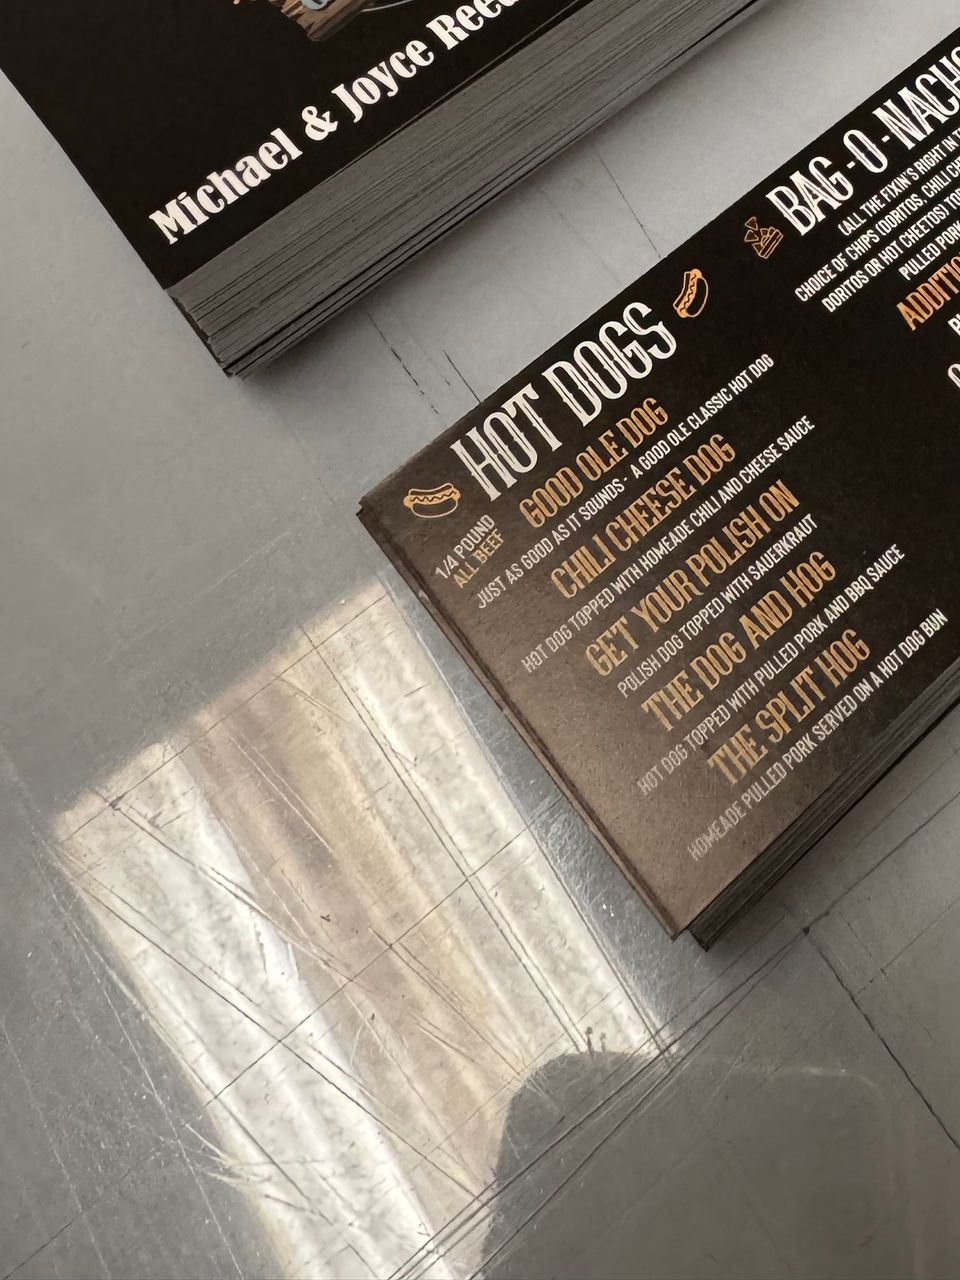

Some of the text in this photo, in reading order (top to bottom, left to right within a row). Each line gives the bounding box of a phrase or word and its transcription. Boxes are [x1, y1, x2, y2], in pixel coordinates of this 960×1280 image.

[149, 128, 302, 244] Michael
[302, 106, 338, 140] &
[331, 41, 434, 122] Joyce
[837, 212, 867, 236] (ALL
[859, 194, 886, 218] THE
[879, 167, 920, 203] FIXIN'S
[913, 143, 947, 175] RIGHT
[941, 135, 960, 153] IN
[794, 263, 838, 302] CHOICE
[830, 252, 849, 272] OF
[844, 229, 880, 261] CHIPS
[874, 193, 928, 236] (DORITOS,
[920, 170, 952, 199] CHILI
[821, 269, 870, 313] DORITOS
[863, 257, 886, 277] OR
[877, 239, 904, 266] HOT
[898, 203, 950, 248] CHEETOS)
[898, 242, 942, 281] PULLED
[449, 301, 677, 502] HOT DOGS
[476, 353, 775, 609] JUST AS GOOD AS IT SOUNDS A GOOD OLE CLASSIC HOT DOG
[519, 397, 669, 528] GOOD OLE DOG
[435, 514, 495, 579] 1/4 POUND
[454, 533, 504, 589] ALL BEEF
[520, 415, 815, 673] HOT DOG TOPPED WITH HOMEADE CHILI AND CHEESE SAUCE
[550, 433, 736, 599] CHILI CHEESE DOG
[585, 478, 800, 676] GET YOUR POLISH ON
[617, 513, 818, 698] POLISH DOG TOPPED WITH SAUERKRAUT
[636, 543, 905, 797] HOT DOG TOPPED WITH PULLED PORK AND BBQ SAUCE
[640, 551, 836, 732] THE DOG AND HOG
[706, 628, 871, 785] THE SPLIT HOG
